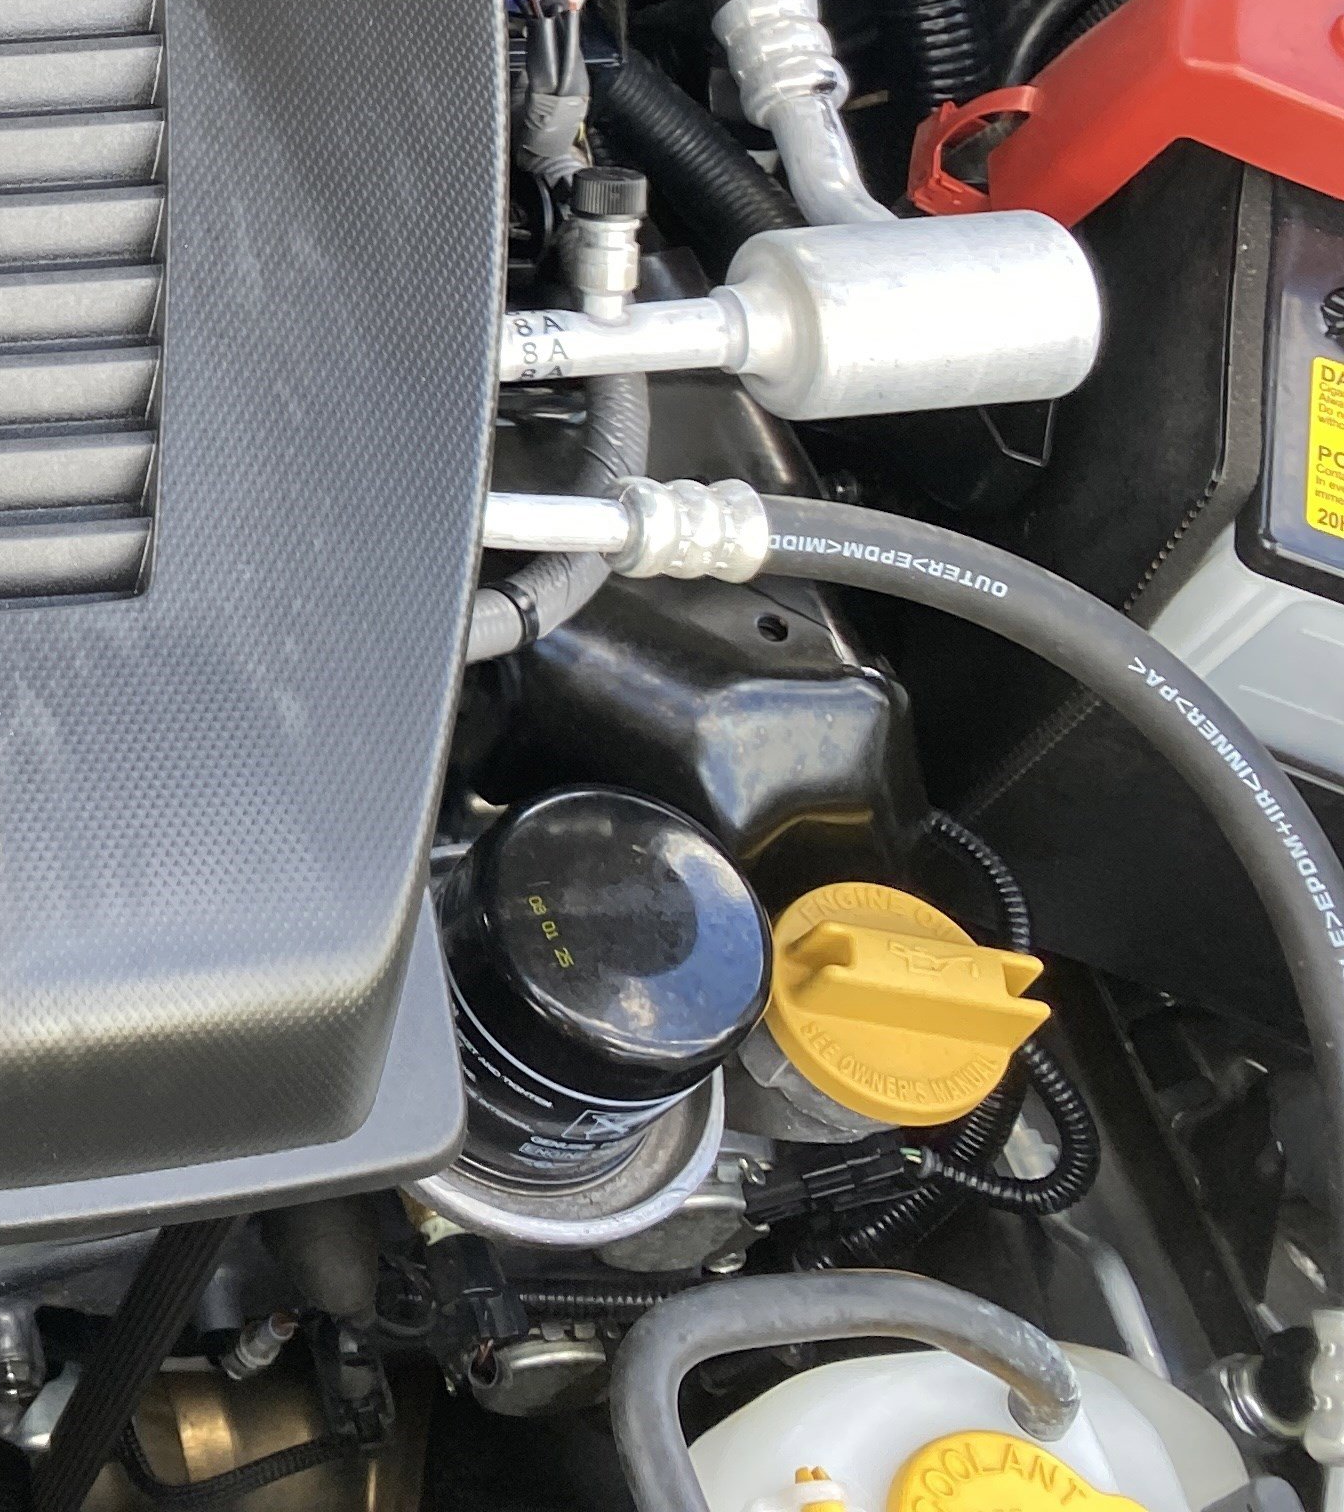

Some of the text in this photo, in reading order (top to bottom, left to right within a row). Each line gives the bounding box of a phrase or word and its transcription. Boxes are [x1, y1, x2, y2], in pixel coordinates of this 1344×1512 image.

[799, 887, 908, 929] ENGINE
[799, 1021, 1000, 1106] SEE OWNER'S MANUAL
